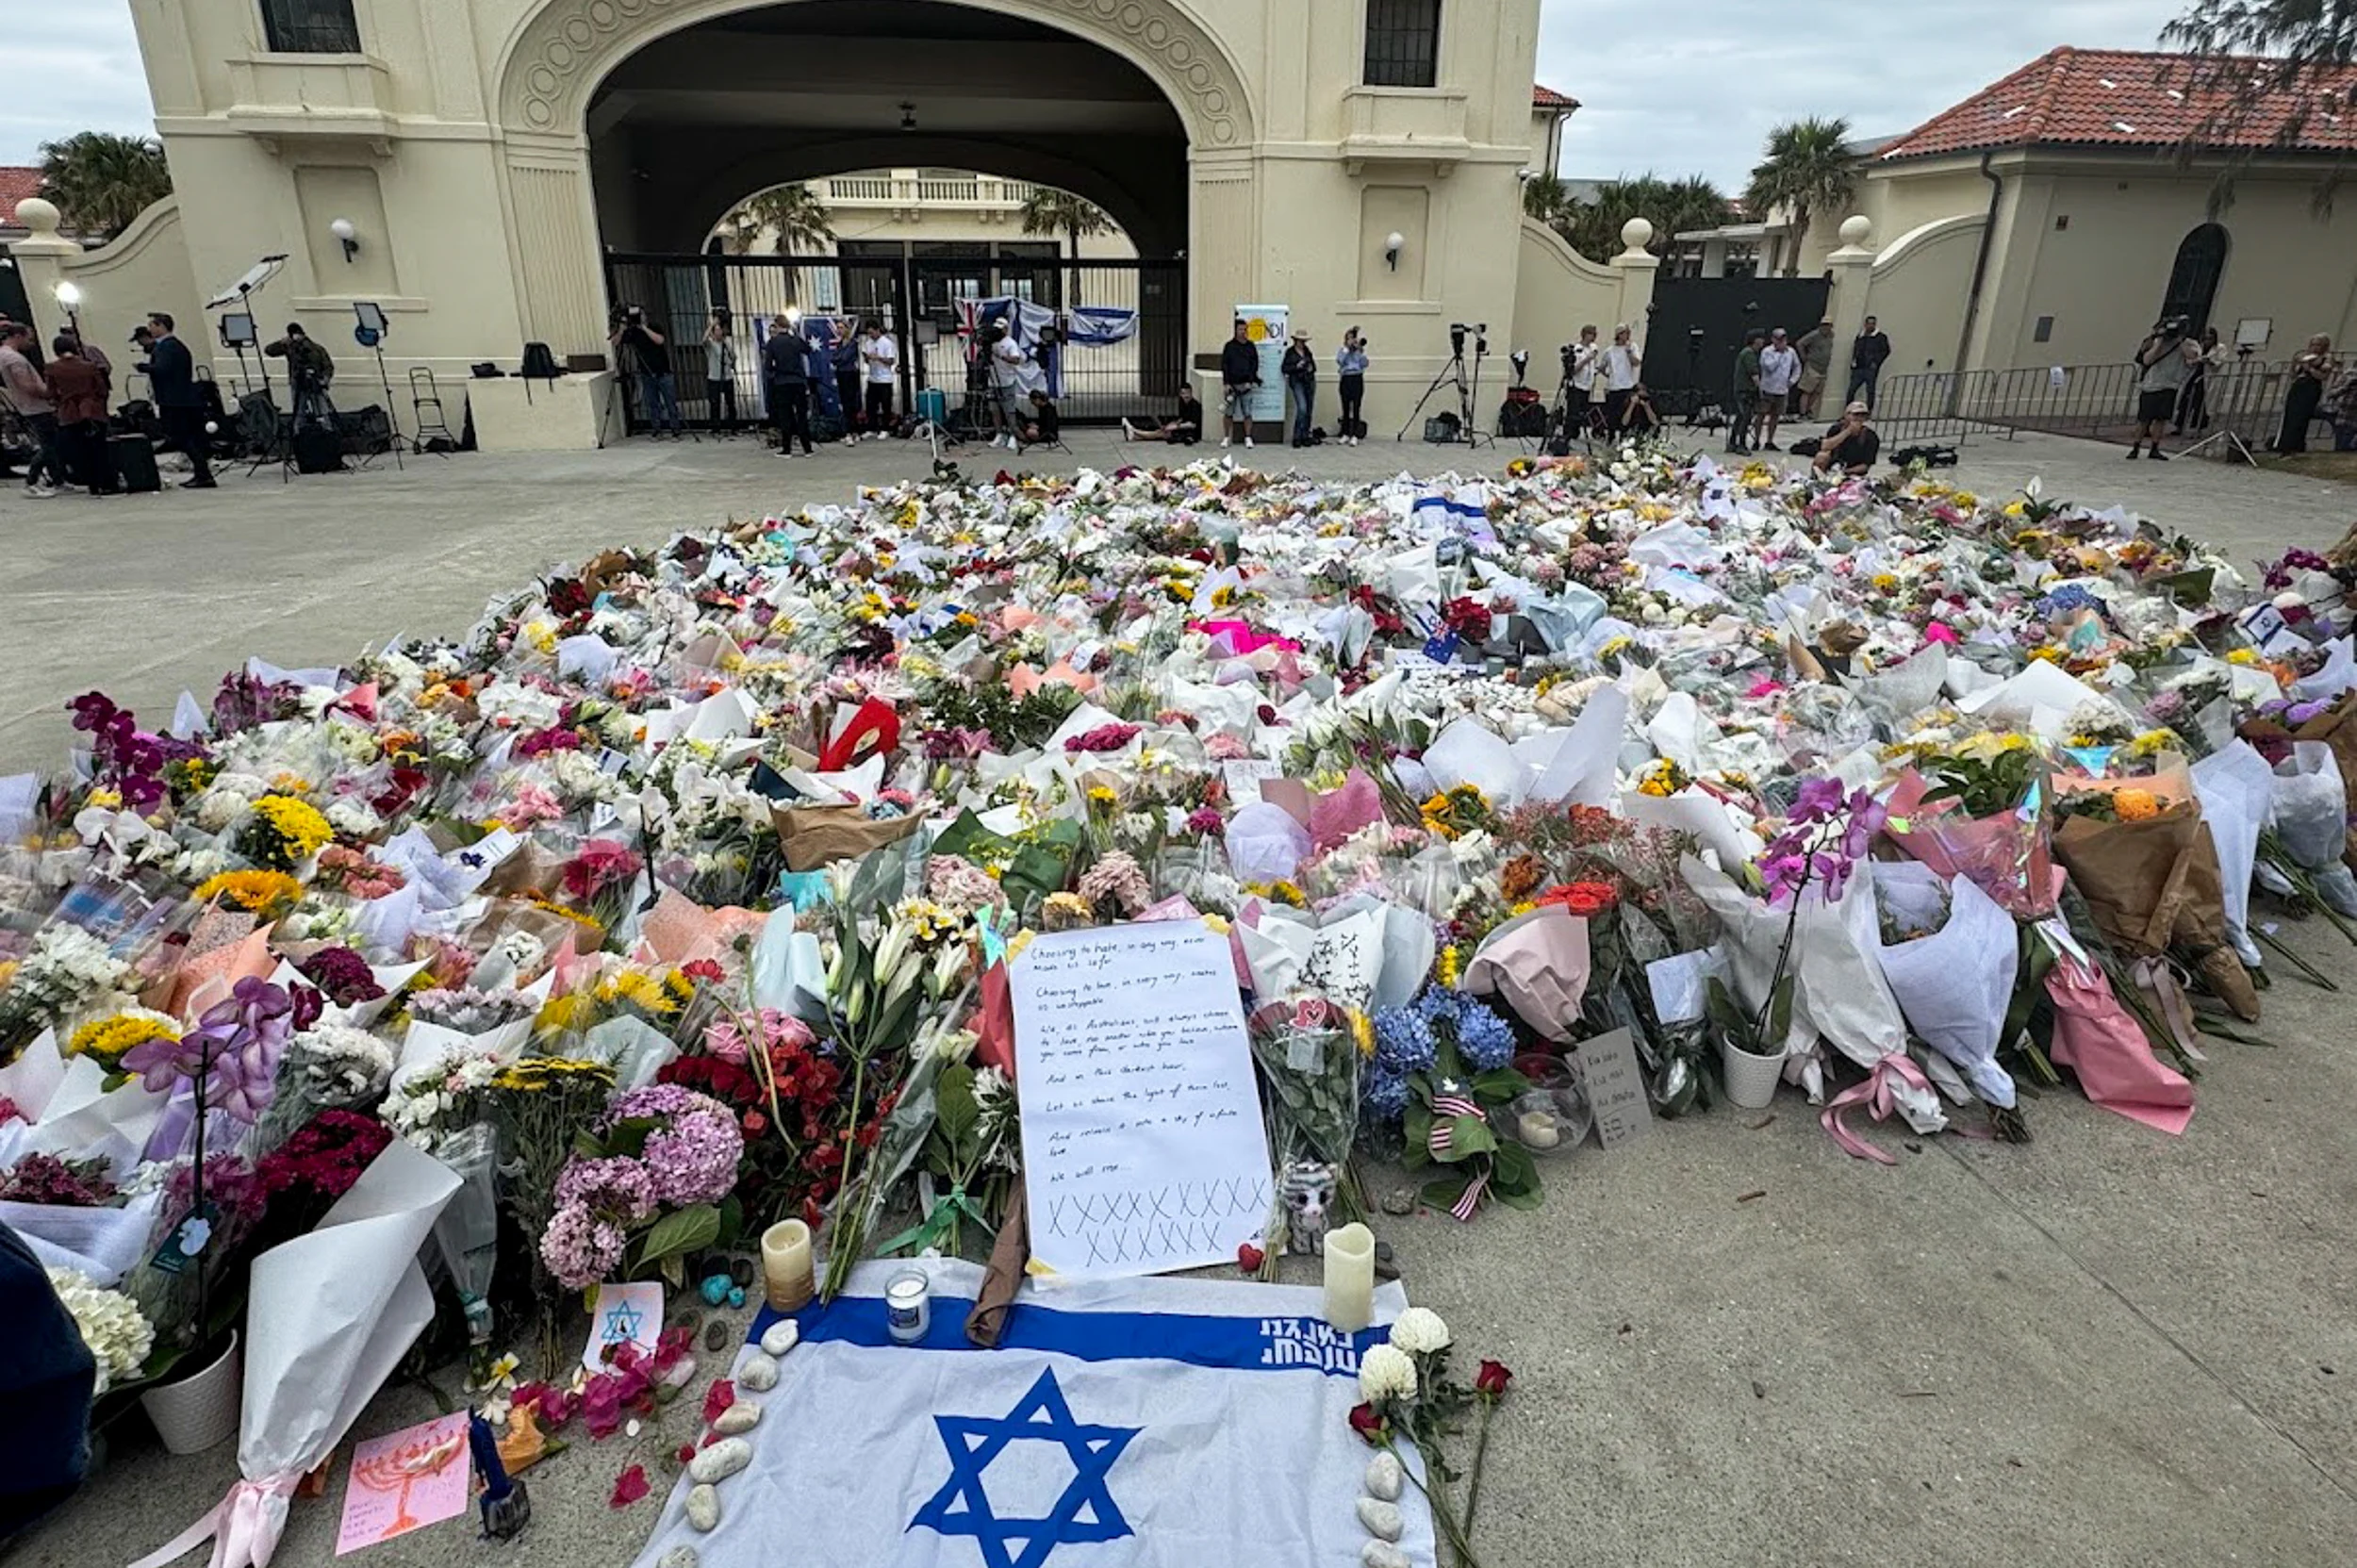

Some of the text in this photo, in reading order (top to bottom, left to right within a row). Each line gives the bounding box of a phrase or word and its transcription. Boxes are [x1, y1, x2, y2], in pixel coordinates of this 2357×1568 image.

[1030, 946, 1077, 961] Choosing
[1081, 943, 1091, 954] to
[1140, 941, 1156, 953] any
[1067, 961, 1079, 969] us
[1088, 953, 1112, 970] safer
[1036, 985, 1077, 1001] Choosing
[1082, 982, 1092, 992] to
[1122, 977, 1131, 986] in
[1137, 976, 1158, 988] every
[1038, 997, 1103, 1012] us unstoppable
[1144, 1015, 1160, 1025] will
[1169, 1014, 1196, 1023] always
[1203, 1010, 1228, 1018] choose
[1041, 1037, 1049, 1046] to
[1105, 1032, 1131, 1041] matter
[1161, 1030, 1176, 1042] you
[1040, 1050, 1055, 1064] you
[1157, 1042, 1172, 1052] you
[1046, 1074, 1066, 1085] And
[1095, 1066, 1112, 1076] this
[1119, 1063, 1156, 1074] darkest
[1046, 1100, 1063, 1113] Let
[1073, 1099, 1083, 1108] us
[1122, 1090, 1137, 1100] the
[1145, 1086, 1165, 1103] light
[1169, 1082, 1182, 1098] of
[1047, 1131, 1072, 1143] And
[1080, 1127, 1112, 1137] release
[1118, 1121, 1126, 1130] it
[1174, 1114, 1188, 1125] sky
[1193, 1111, 1205, 1128] of
[1049, 1146, 1066, 1158] love
[1050, 1171, 1064, 1183] We
[1075, 1164, 1094, 1179] will
